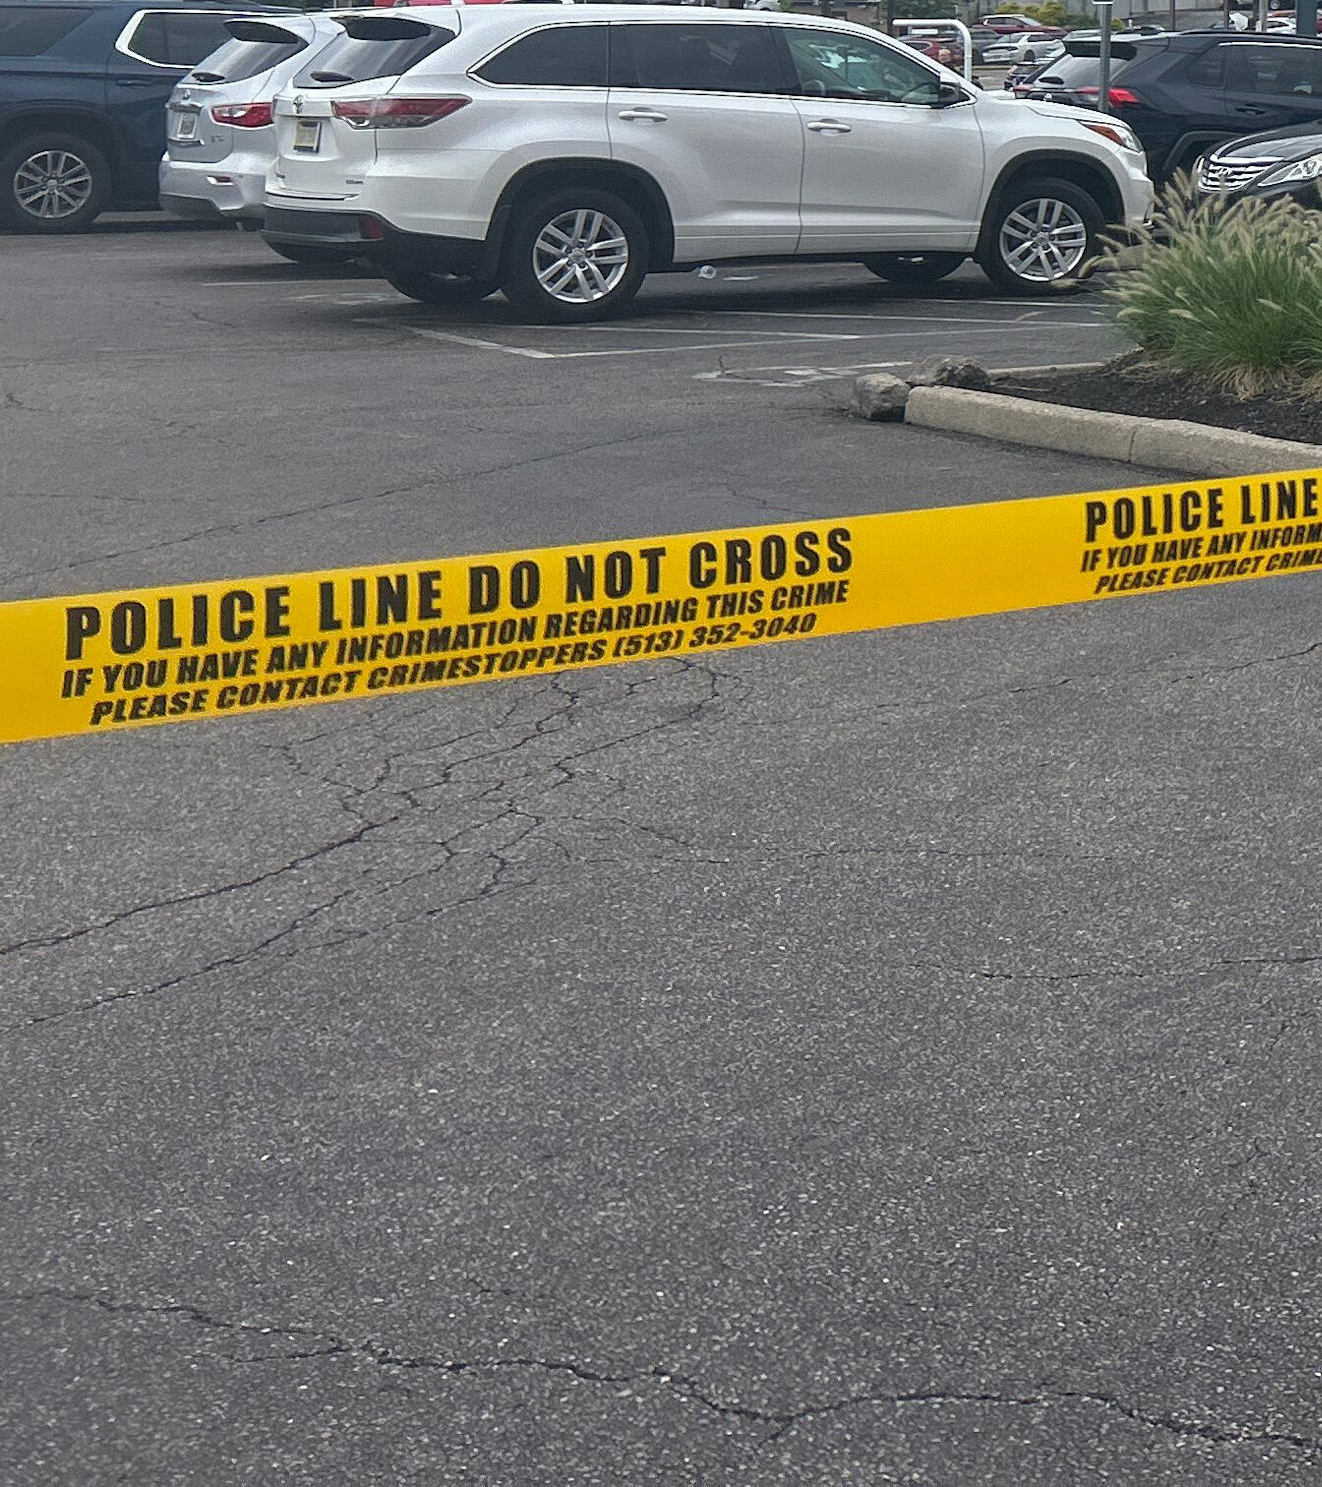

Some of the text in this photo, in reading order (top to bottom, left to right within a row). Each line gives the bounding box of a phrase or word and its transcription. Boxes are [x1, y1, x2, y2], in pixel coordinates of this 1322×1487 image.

[1080, 549, 1102, 573] IF
[1107, 542, 1149, 568] YOU
[1152, 537, 1203, 563] HAVE
[1206, 531, 1247, 555] ANY
[1085, 487, 1224, 543] POLICE
[1241, 478, 1318, 524] LINE
[65, 527, 853, 661] POLICE LINE DO NOT CROSS
[1094, 568, 1169, 595] PLEASE
[1173, 555, 1263, 584] CONTACT
[61, 580, 850, 699] IF YOU HAVE ANY INFORMATION REGARDING THIS CRIME
[89, 613, 817, 726] PLEASE CONTACT CRIMESTOPPERS (513) 352-3040
